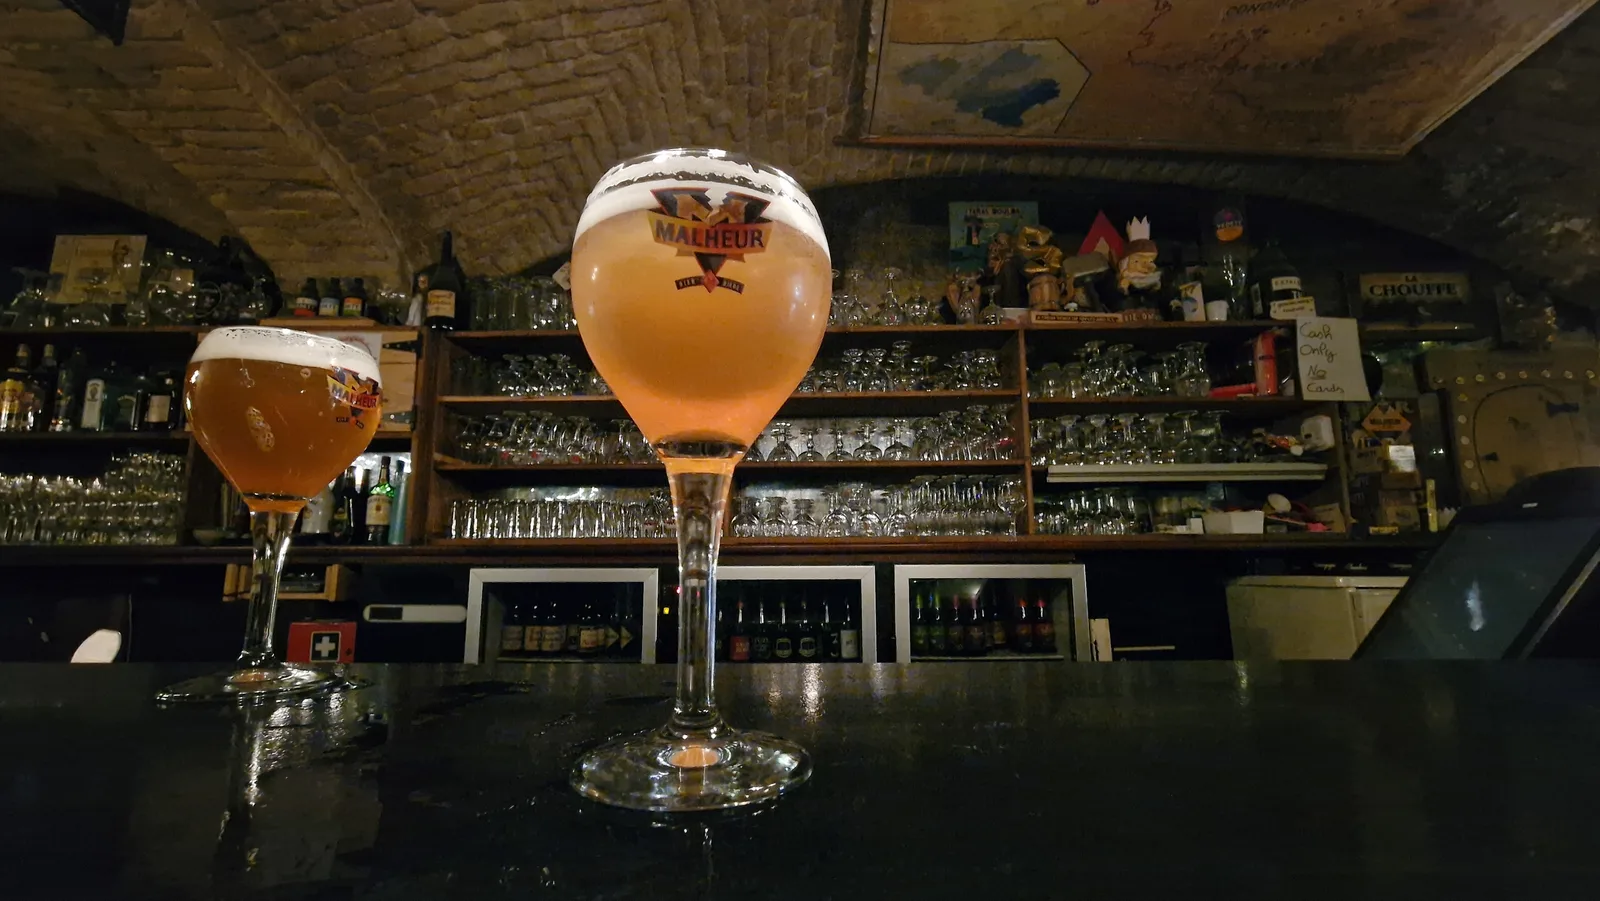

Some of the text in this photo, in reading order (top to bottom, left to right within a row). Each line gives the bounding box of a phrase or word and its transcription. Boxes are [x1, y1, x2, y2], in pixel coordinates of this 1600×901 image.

[655, 219, 765, 249] MALHEUR
[1369, 283, 1458, 297] CHOUFFE
[1300, 321, 1333, 340] Cash
[1300, 341, 1338, 363] Only
[1308, 364, 1327, 379] No
[1306, 382, 1345, 393] Cards
